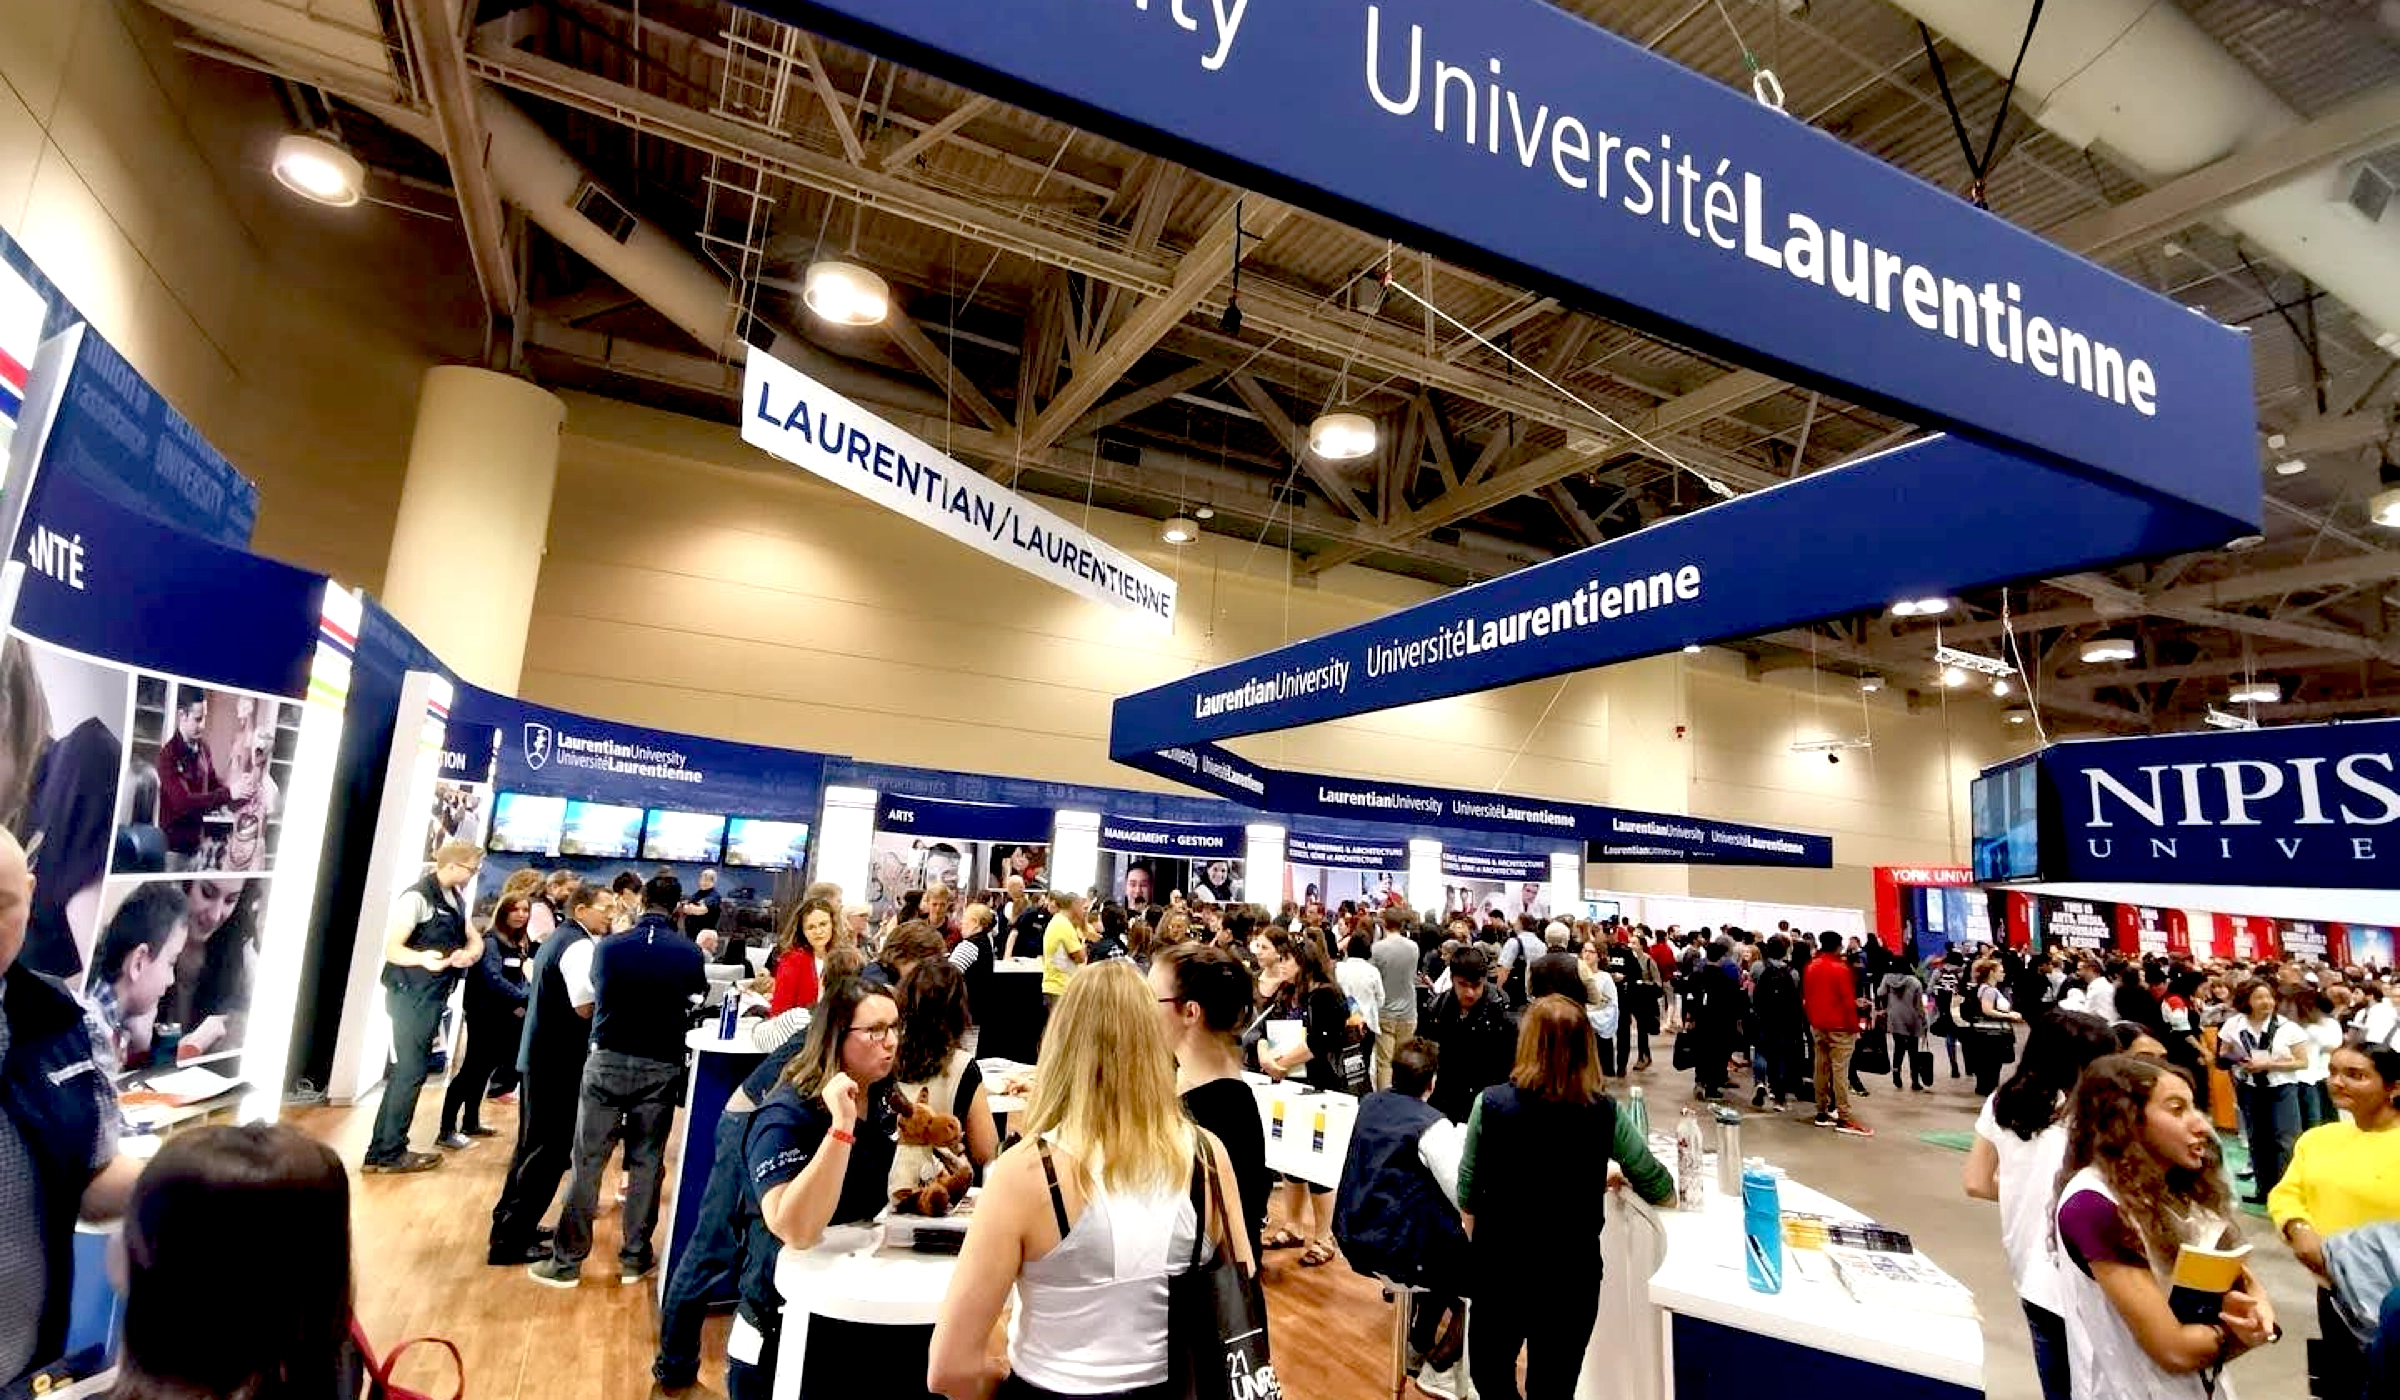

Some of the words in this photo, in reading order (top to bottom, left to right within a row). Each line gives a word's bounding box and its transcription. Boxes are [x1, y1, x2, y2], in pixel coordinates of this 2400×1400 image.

[1364, 4, 2158, 416] UniversitéLaurentienne
[757, 381, 1172, 619] LAURENTIAN/LAURENTIENNE
[1195, 656, 1351, 718] LaurentianUniversity
[1366, 564, 1702, 678] UniversitéLaurentienne
[557, 731, 687, 768] LaurentianUniversity
[556, 752, 703, 783] UniversitéLaurentienne
[888, 809, 915, 823] ARTS
[1318, 786, 1444, 816] LaurentianUniversity
[1451, 800, 1576, 828] UniversitéLaurentienne
[1104, 827, 1168, 844] MANAGEMENT
[1177, 834, 1223, 848] GESTION
[1892, 869, 1931, 882] YORK
[1226, 1349, 1249, 1378] 21
